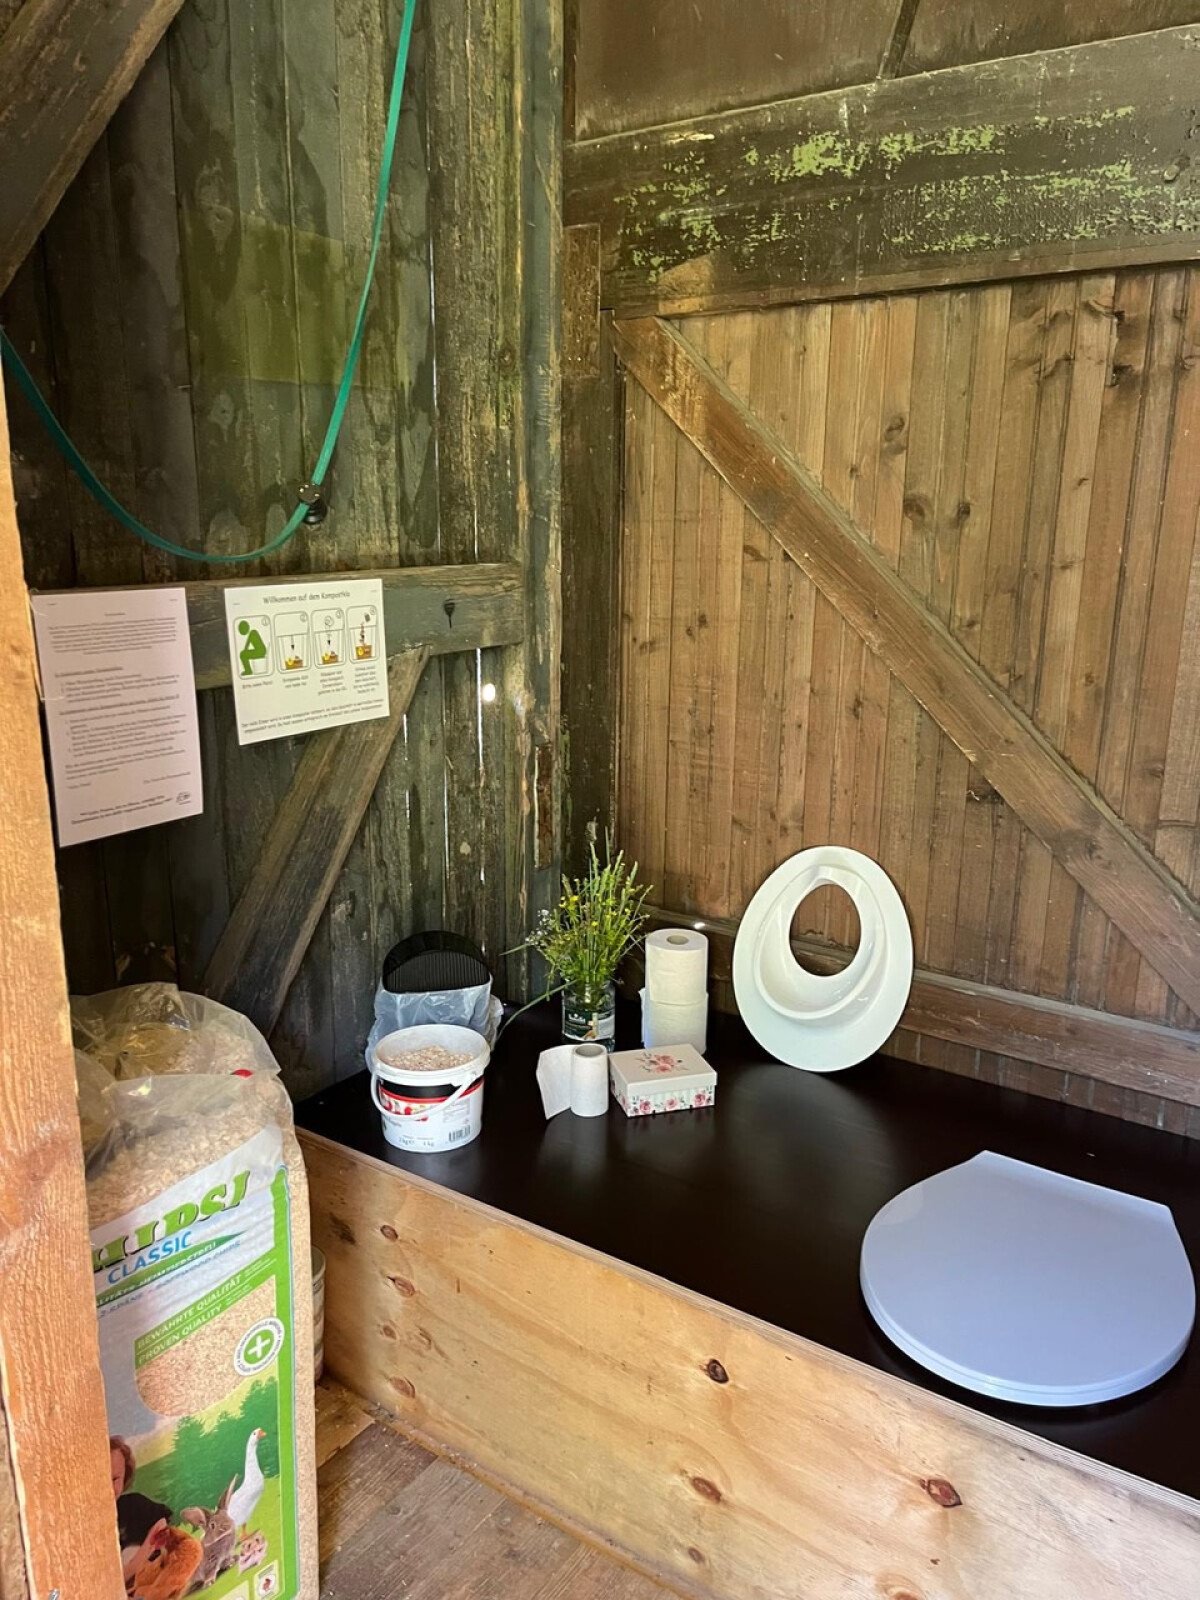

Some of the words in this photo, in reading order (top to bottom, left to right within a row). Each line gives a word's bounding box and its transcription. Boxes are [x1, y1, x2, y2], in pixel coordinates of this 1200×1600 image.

[263, 595, 297, 604] Willkommen
[299, 593, 307, 601] auf
[108, 1231, 191, 1284] CLASSIC
[139, 1332, 181, 1364] PROVEN
[182, 1304, 222, 1336] QUALITY
